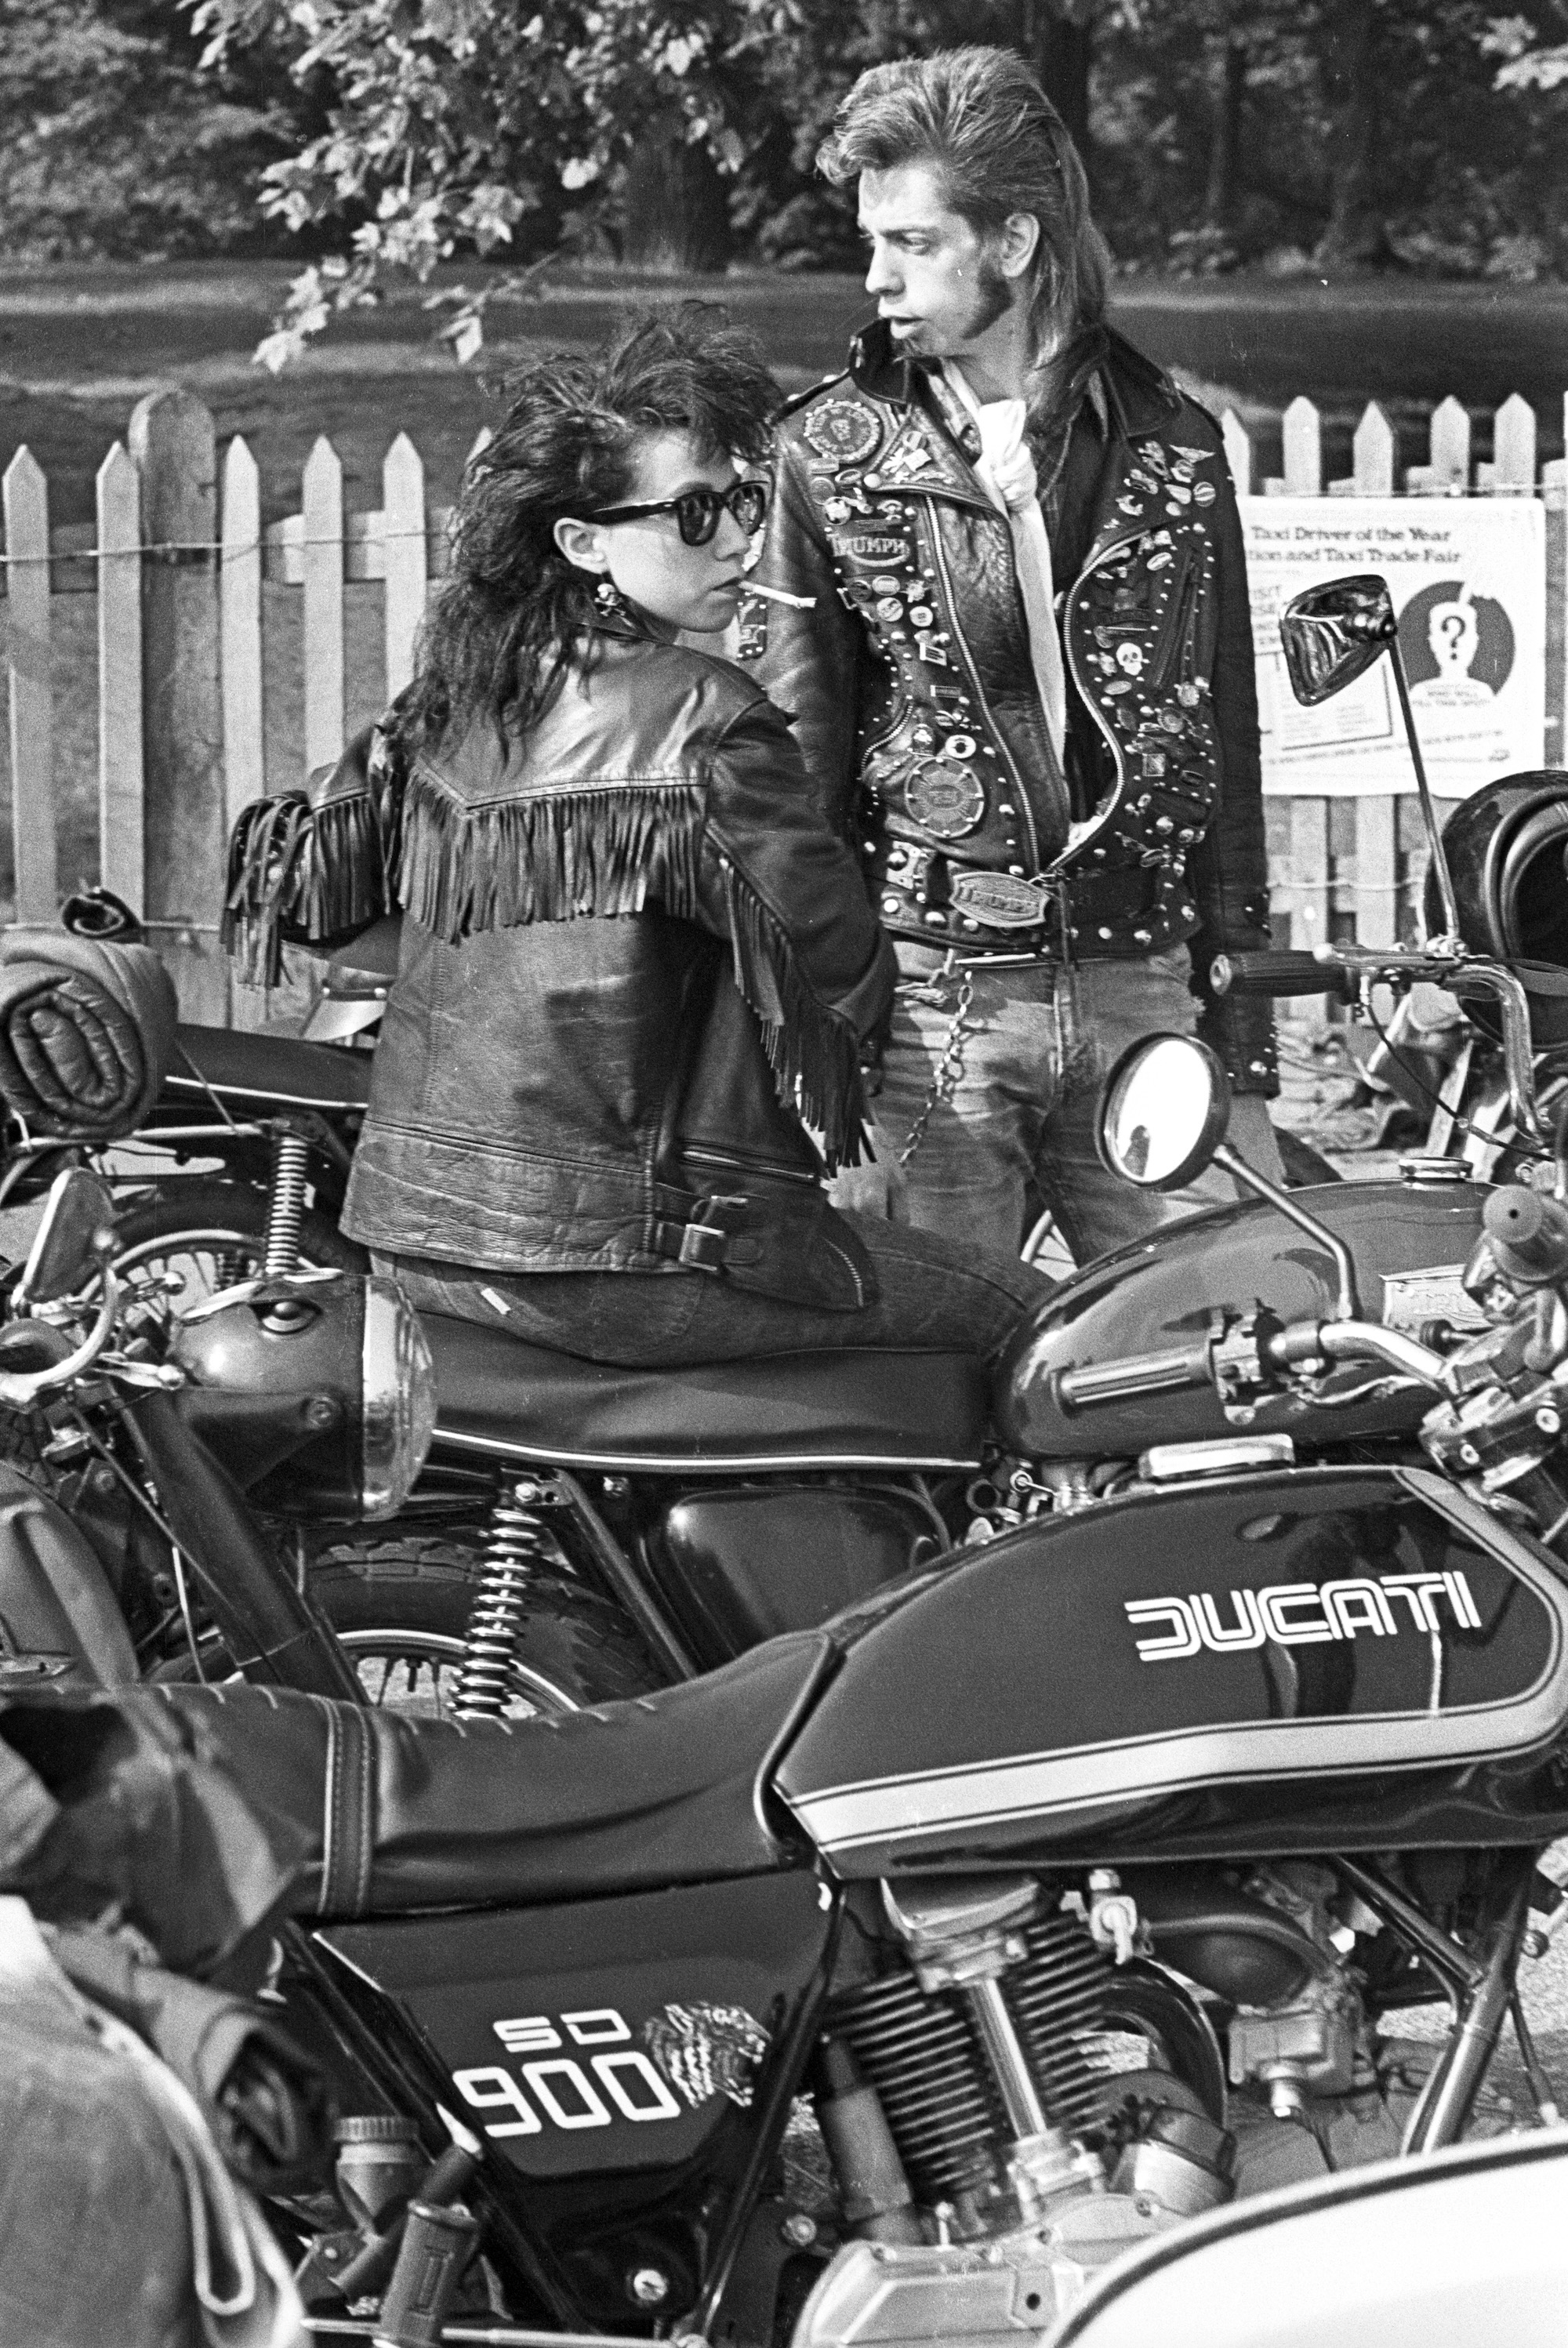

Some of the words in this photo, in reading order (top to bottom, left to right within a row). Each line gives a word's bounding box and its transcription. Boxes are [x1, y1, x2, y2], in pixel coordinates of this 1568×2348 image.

[826, 533, 908, 557] TRIUMPH
[1251, 525, 1290, 540] Taxi
[1295, 526, 1351, 540] Driver
[1355, 528, 1372, 540] of
[1376, 527, 1404, 541] the
[1409, 527, 1451, 541] Year
[1249, 550, 1282, 561] tion
[1286, 548, 1320, 561] and
[1324, 547, 1363, 561] Taxi
[1366, 547, 1419, 562] Trade
[1423, 548, 1461, 563] Fair
[1123, 1570, 1483, 1661] DUCATI
[492, 2008, 632, 2052] SD
[452, 2051, 681, 2138] 900
